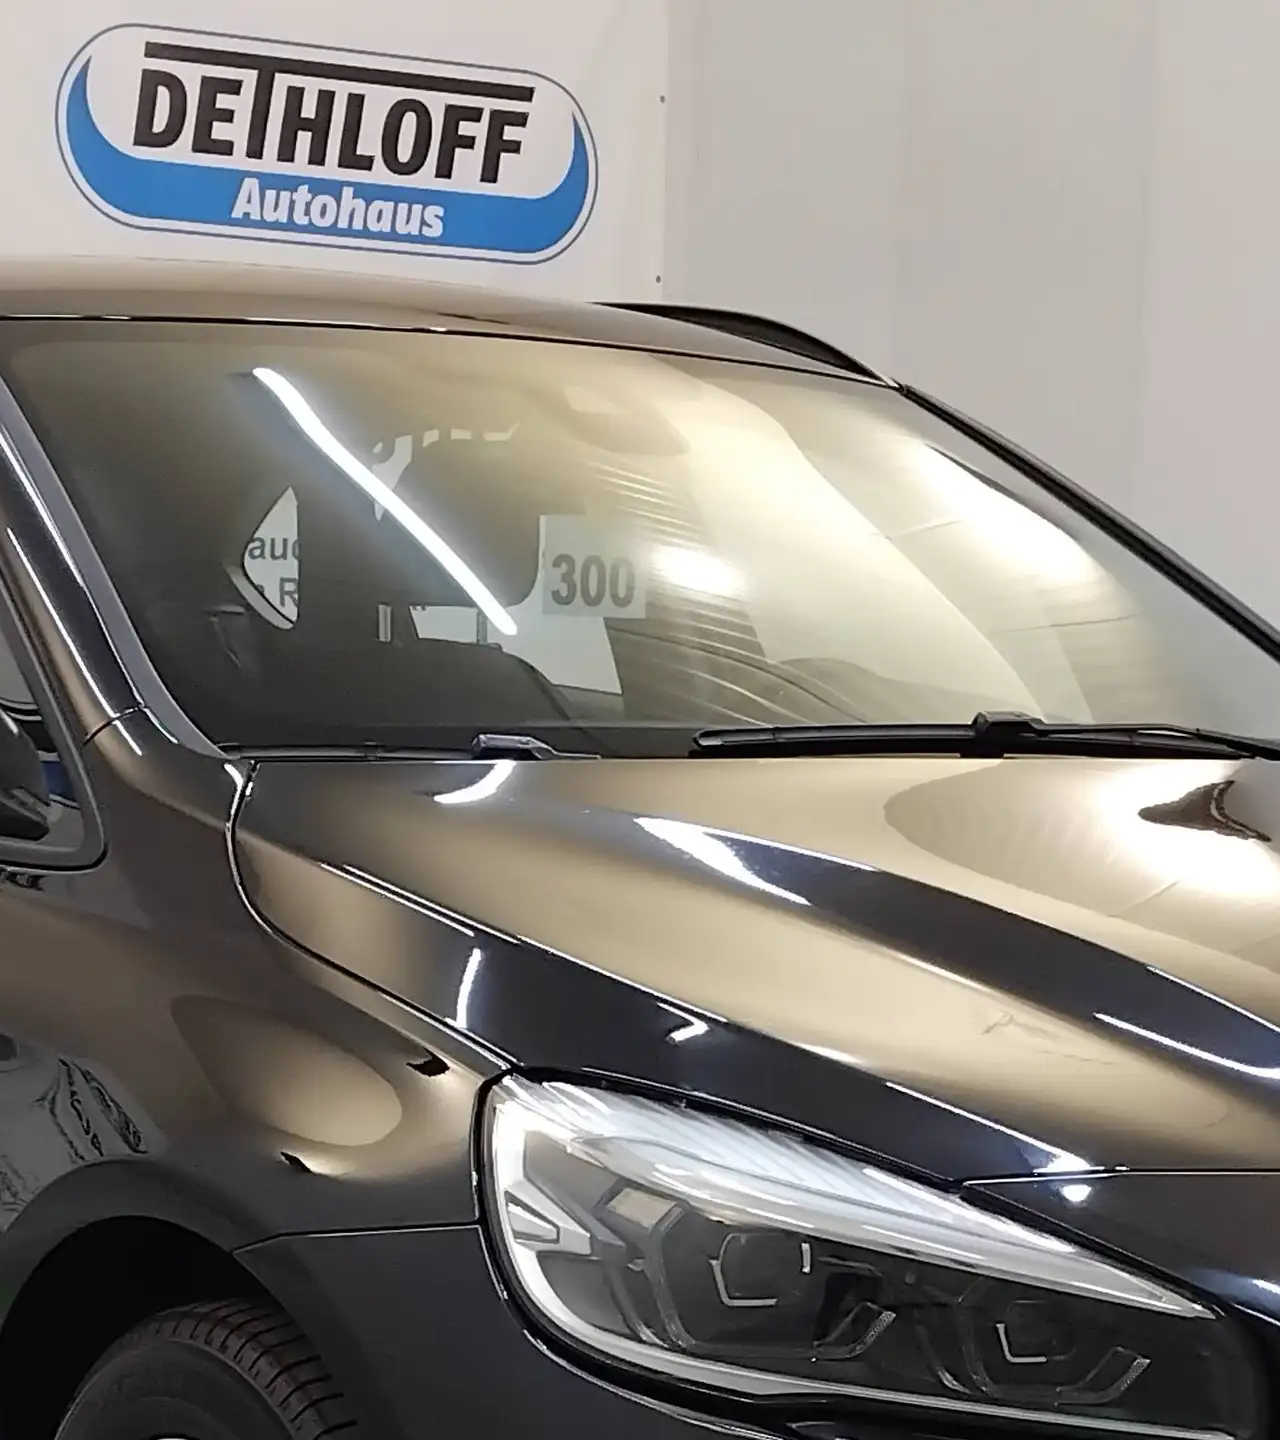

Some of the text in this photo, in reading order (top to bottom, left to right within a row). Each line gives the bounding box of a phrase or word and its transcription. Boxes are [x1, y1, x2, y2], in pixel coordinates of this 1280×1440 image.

[133, 41, 536, 184] DETHLOFF
[231, 177, 445, 239] Autohaus
[551, 553, 636, 608] 300
